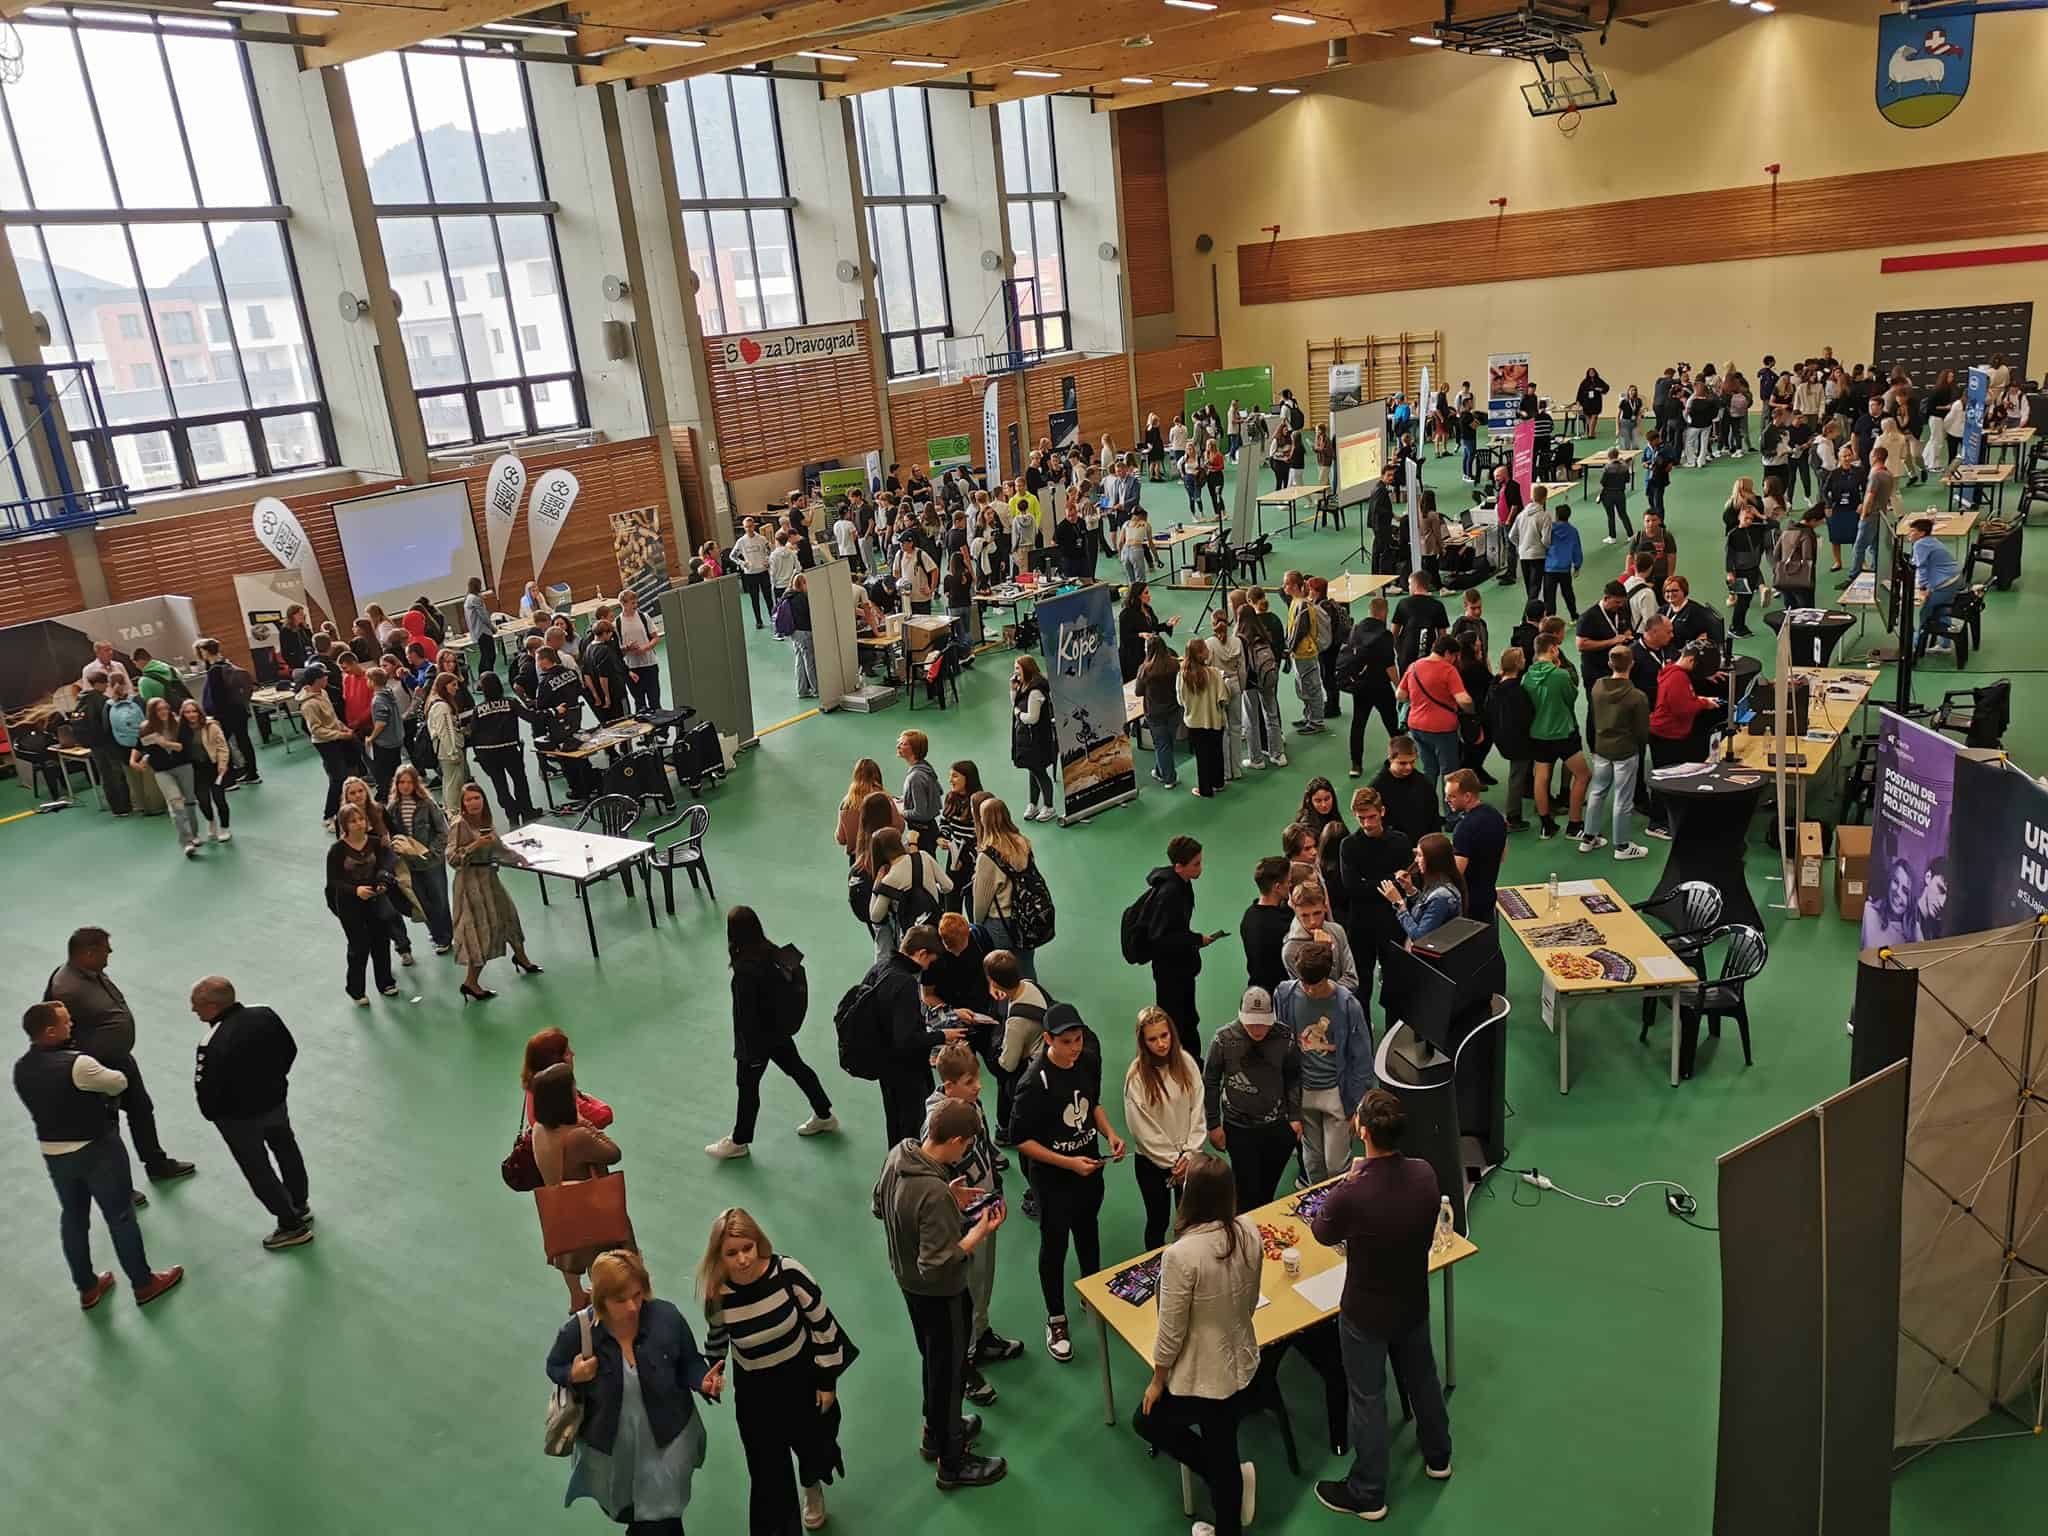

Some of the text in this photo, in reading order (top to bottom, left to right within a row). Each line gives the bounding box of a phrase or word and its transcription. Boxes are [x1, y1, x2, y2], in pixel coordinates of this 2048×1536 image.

[726, 329, 855, 363] S za Dravograd
[118, 623, 153, 640] TAB
[1057, 623, 1097, 677] Kope
[1884, 781, 1931, 815] SVETOVNIH
[1885, 767, 1938, 806] POSTANI DEL
[1883, 793, 1931, 829] PROJEKTOV
